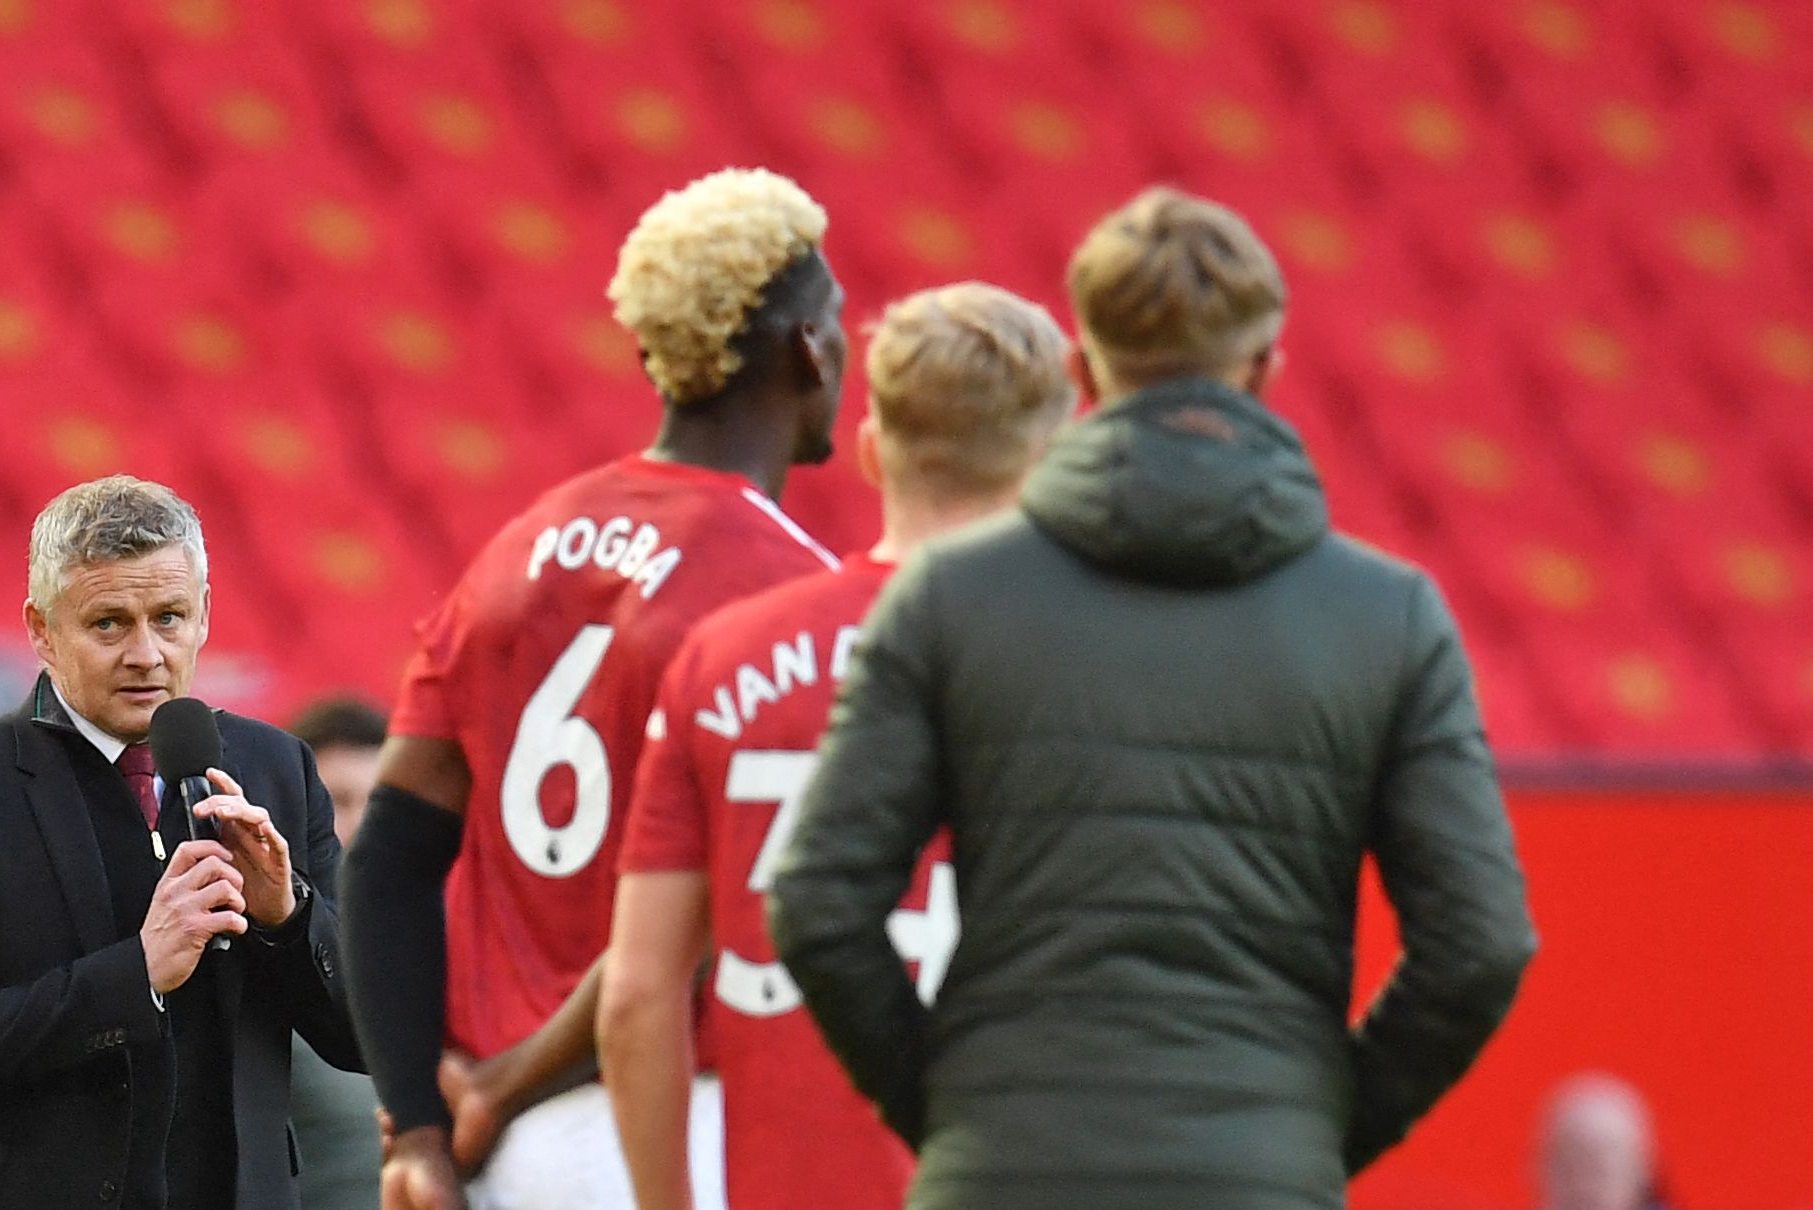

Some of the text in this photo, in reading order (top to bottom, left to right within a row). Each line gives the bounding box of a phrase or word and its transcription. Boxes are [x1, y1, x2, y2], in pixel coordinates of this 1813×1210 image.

[527, 515, 683, 600] POGBA
[695, 632, 817, 741] VAN
[501, 623, 614, 878] 6
